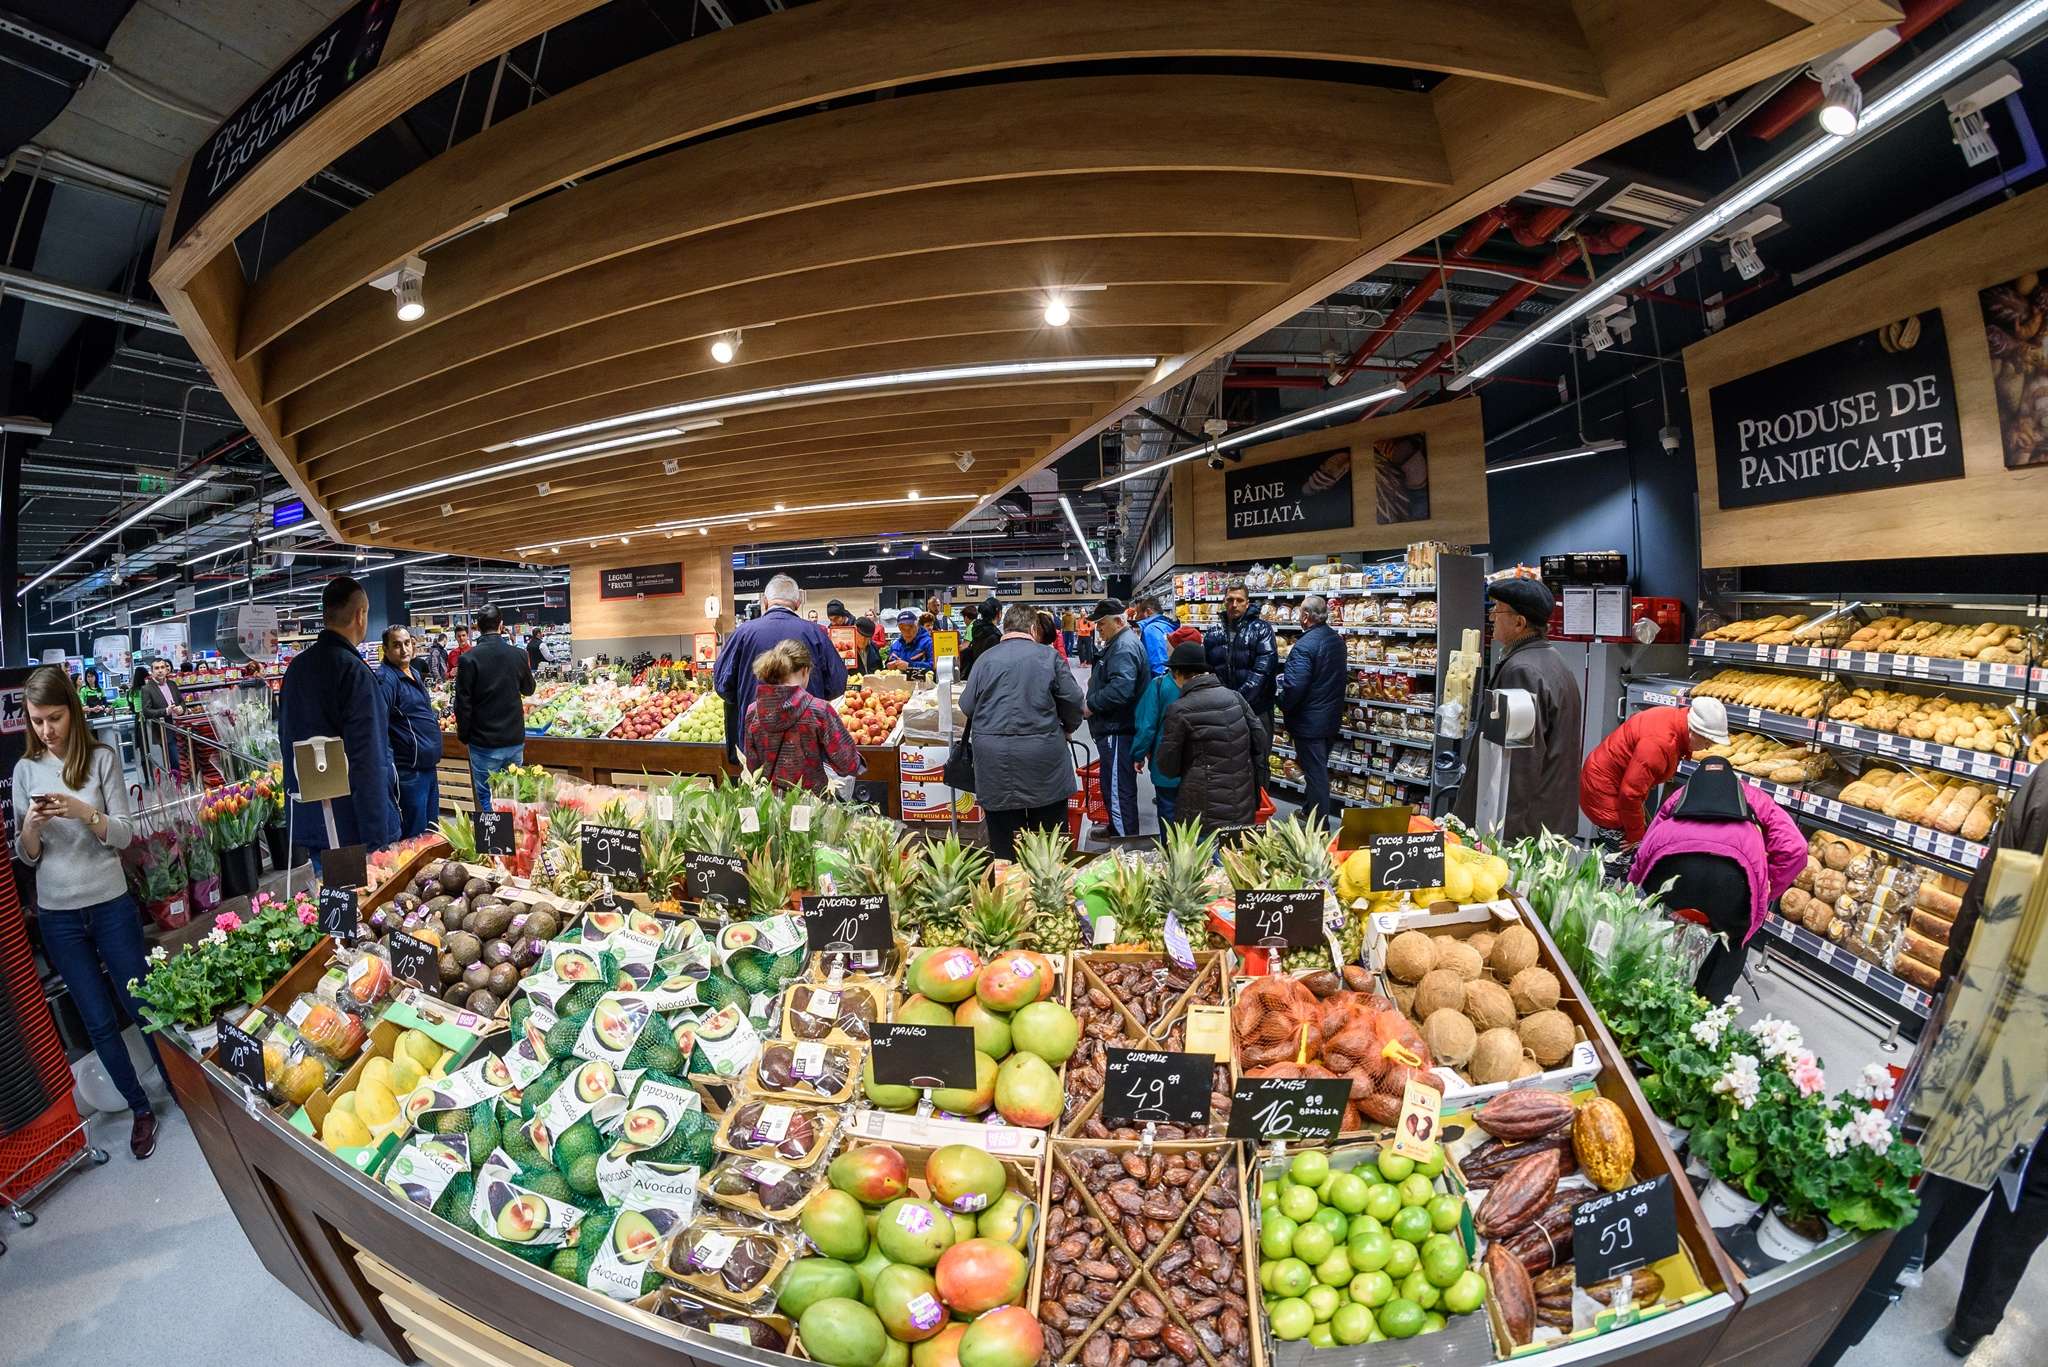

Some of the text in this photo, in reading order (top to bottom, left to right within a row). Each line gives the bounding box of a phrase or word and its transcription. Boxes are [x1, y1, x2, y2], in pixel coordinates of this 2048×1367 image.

[207, 60, 305, 168] FRUCTE
[207, 73, 323, 198] LEGUME
[1737, 374, 1941, 453] PRODUSE DE
[1739, 422, 1947, 490] PANIFICAȚIE
[1233, 481, 1285, 504] PÂINE
[1233, 499, 1306, 528] FELIATĂ
[608, 572, 633, 582] LEGUME
[734, 577, 760, 588] mănești
[901, 751, 924, 763] Dole
[903, 789, 926, 801] Dole
[597, 838, 610, 866] 9
[610, 837, 620, 847] 99
[696, 854, 725, 865] AVOCADO
[1383, 851, 1405, 886] 2
[1407, 846, 1419, 858] 49
[697, 871, 710, 894] 9
[817, 897, 858, 909] AVOCADO
[1245, 892, 1320, 903] SNAKE FRUIT
[832, 912, 870, 942] 10 99
[1256, 904, 1295, 937] 49 99
[619, 929, 659, 947] Avocado
[396, 954, 425, 979] 13 99
[655, 995, 699, 1011] Avocado
[873, 1038, 885, 1046] CAL
[890, 1026, 928, 1037] MANGO
[1126, 1052, 1169, 1065] CURMALE
[641, 1084, 686, 1106] Avocado
[1126, 1074, 1181, 1109] 49 99
[1260, 1078, 1308, 1091] LIMES
[1251, 1094, 1324, 1136] 16 99
[633, 1179, 692, 1196] Avocado
[1631, 1180, 1657, 1197] CACAO
[1599, 1202, 1649, 1256] 59 99
[591, 1264, 639, 1290] Avocado
